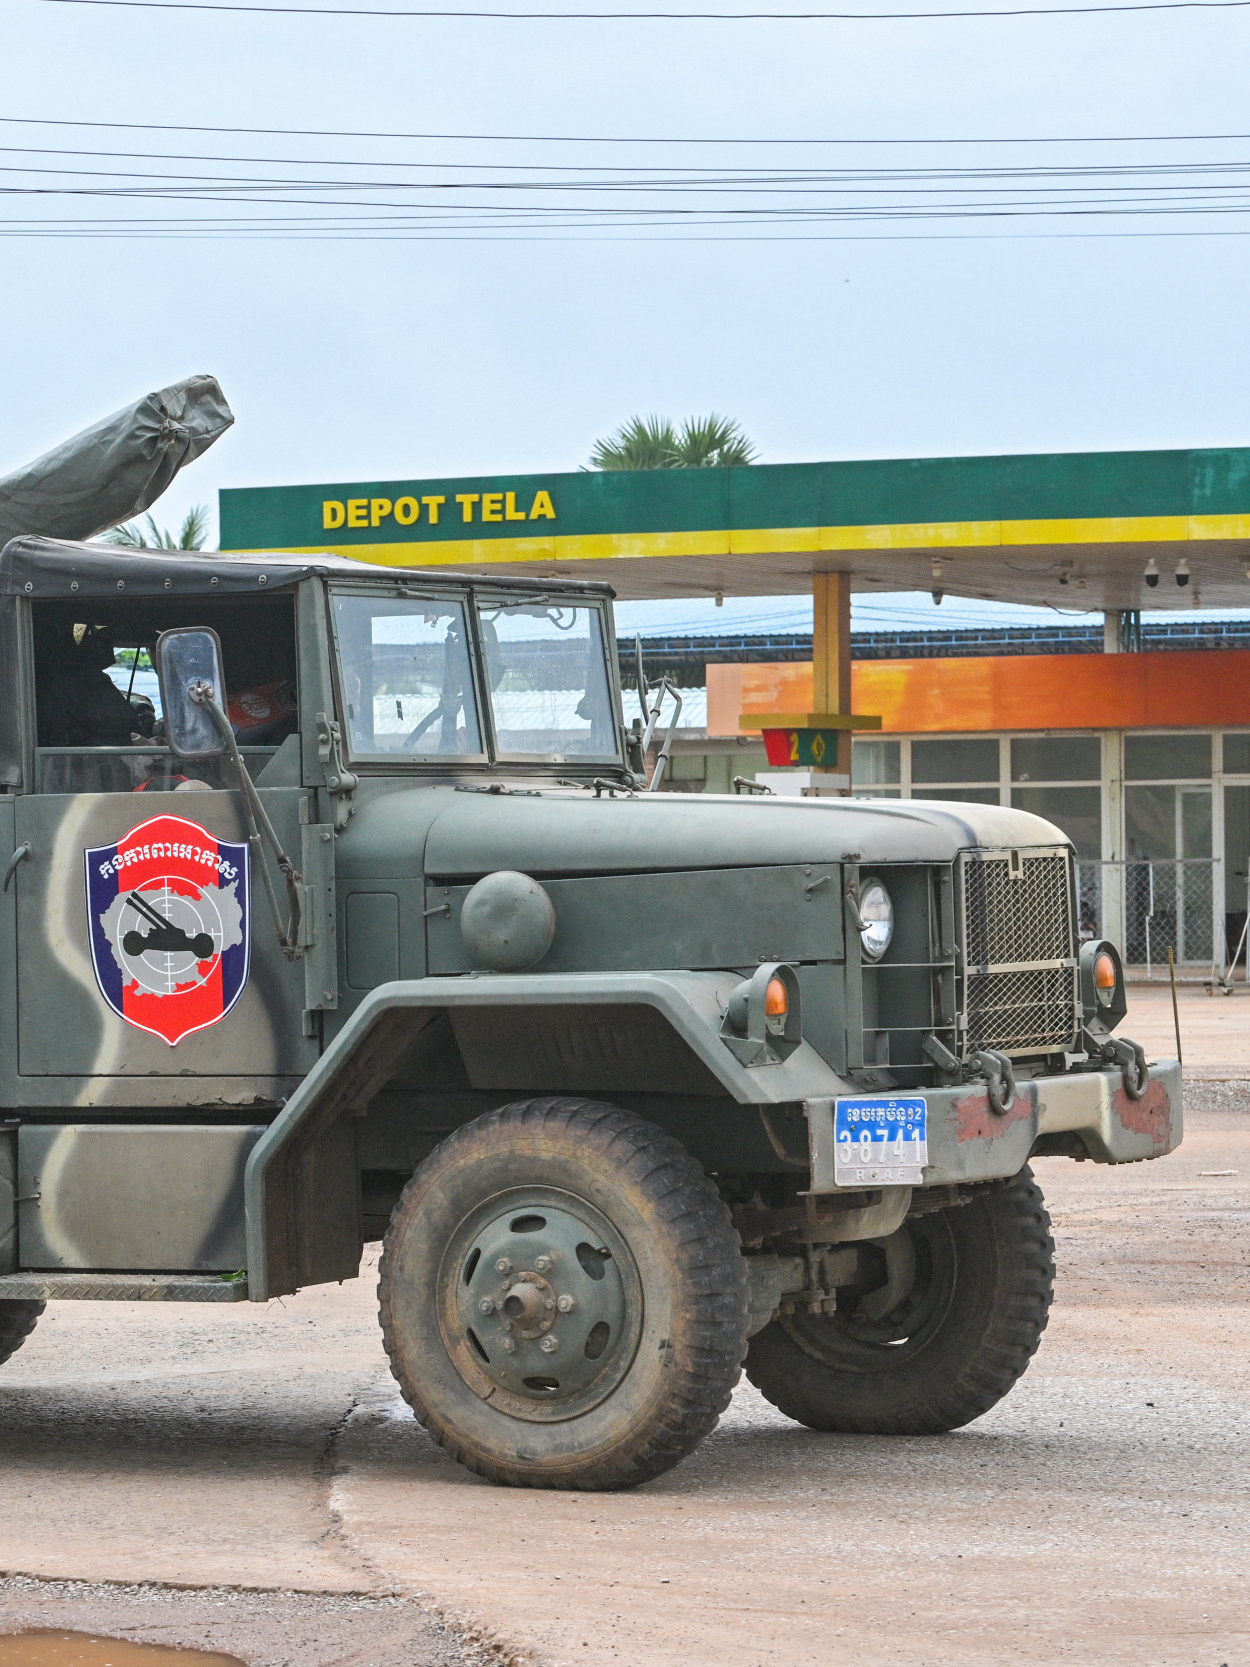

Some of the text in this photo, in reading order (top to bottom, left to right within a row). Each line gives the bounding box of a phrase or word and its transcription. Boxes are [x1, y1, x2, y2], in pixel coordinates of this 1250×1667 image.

[322, 490, 557, 530] DEPOT TELA
[98, 842, 239, 880] កងការពារអាកាស
[839, 1128, 921, 1164] 3-8741
[855, 1168, 907, 1181] RCAF
